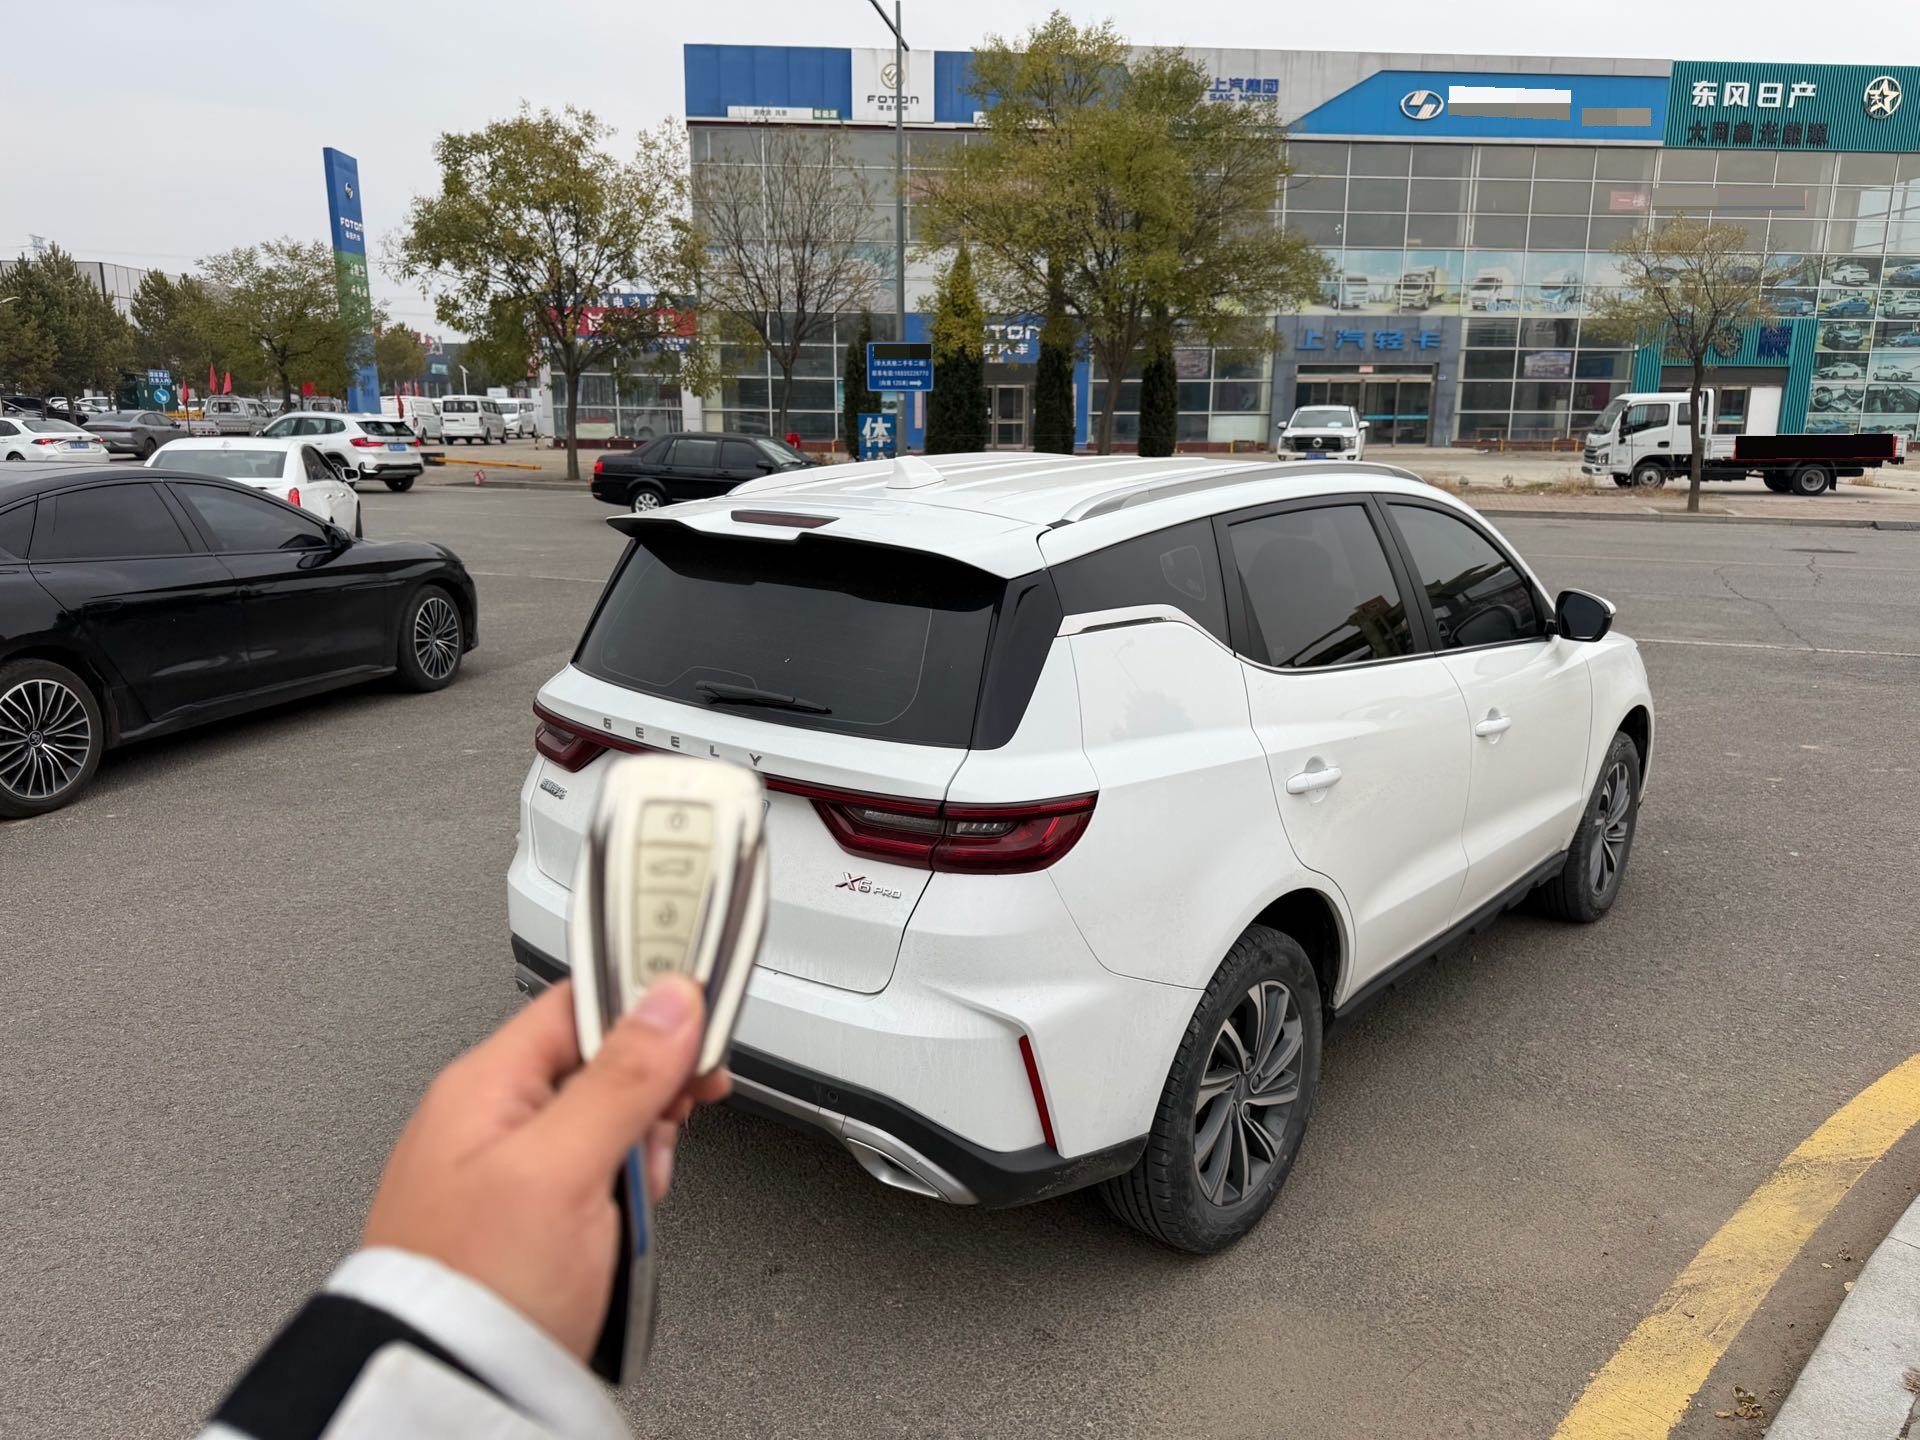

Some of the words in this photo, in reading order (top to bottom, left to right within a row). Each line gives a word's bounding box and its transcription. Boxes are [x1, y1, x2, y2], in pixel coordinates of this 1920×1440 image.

[1208, 77, 1279, 94] 上汽集团
[1209, 93, 1235, 101] SAIC
[1692, 81, 1817, 109] 东风日产
[1295, 328, 1441, 351] 上汽轻卡
[603, 717, 762, 767] GEELY
